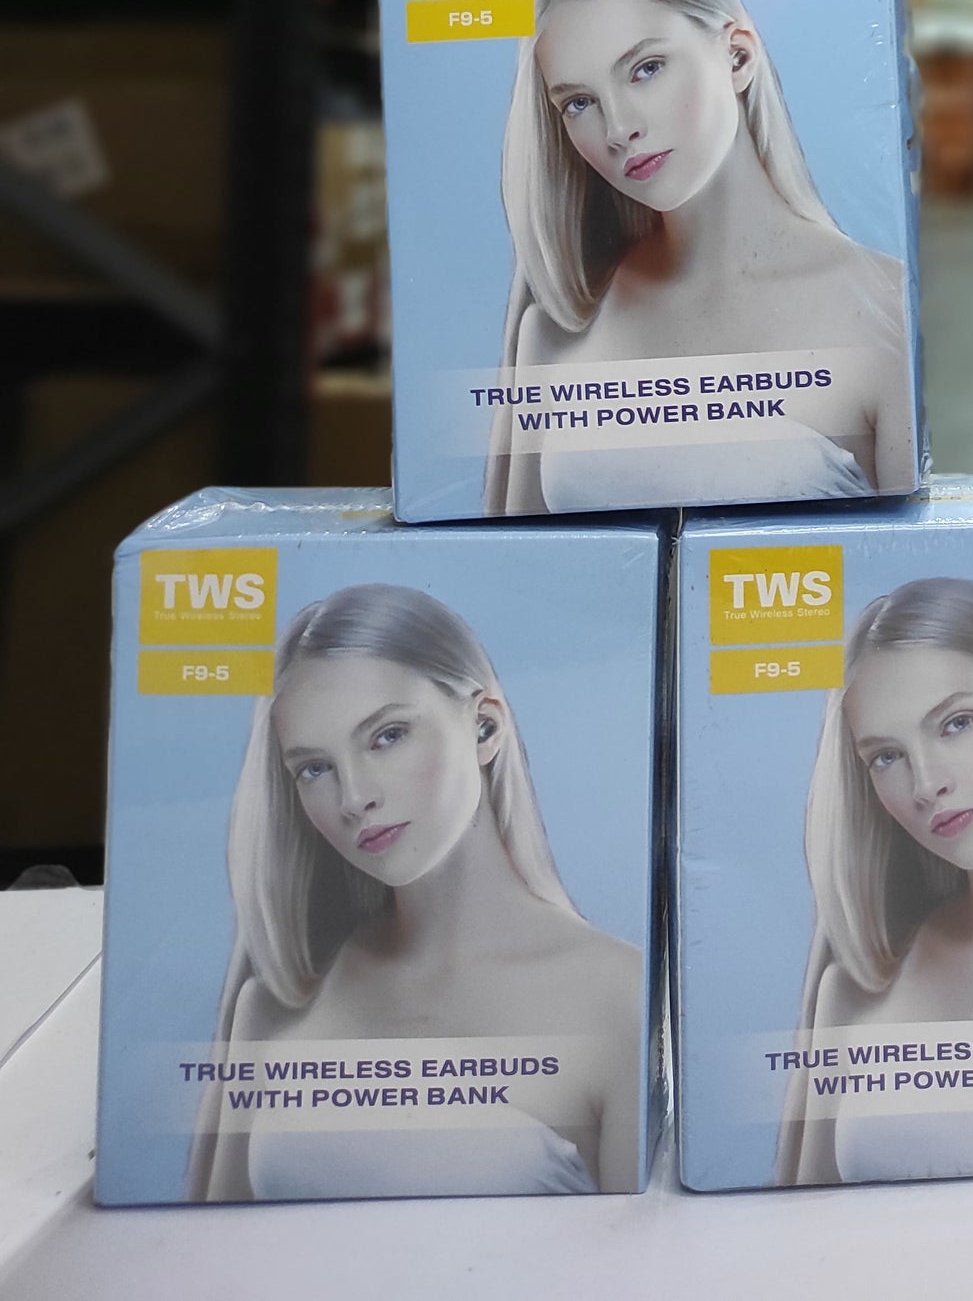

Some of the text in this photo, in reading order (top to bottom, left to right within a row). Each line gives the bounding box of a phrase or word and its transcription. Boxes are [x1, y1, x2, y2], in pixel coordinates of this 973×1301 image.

[449, 11, 492, 27] F9-5
[470, 369, 832, 406] TRUE WIRELESS EARBUDS
[518, 399, 785, 431] WITH POWER BANK
[155, 573, 265, 609] TWS
[723, 571, 831, 608] TWS
[724, 608, 830, 619] True Wireless Stereo
[183, 665, 229, 680] F9-5
[755, 662, 800, 678] F9-5
[179, 1057, 559, 1082] TRUE WIRELESS EARBUDS
[765, 1048, 838, 1071] TRUE
[814, 1074, 885, 1095] WITH
[229, 1086, 509, 1109] WITH POWER BANK
